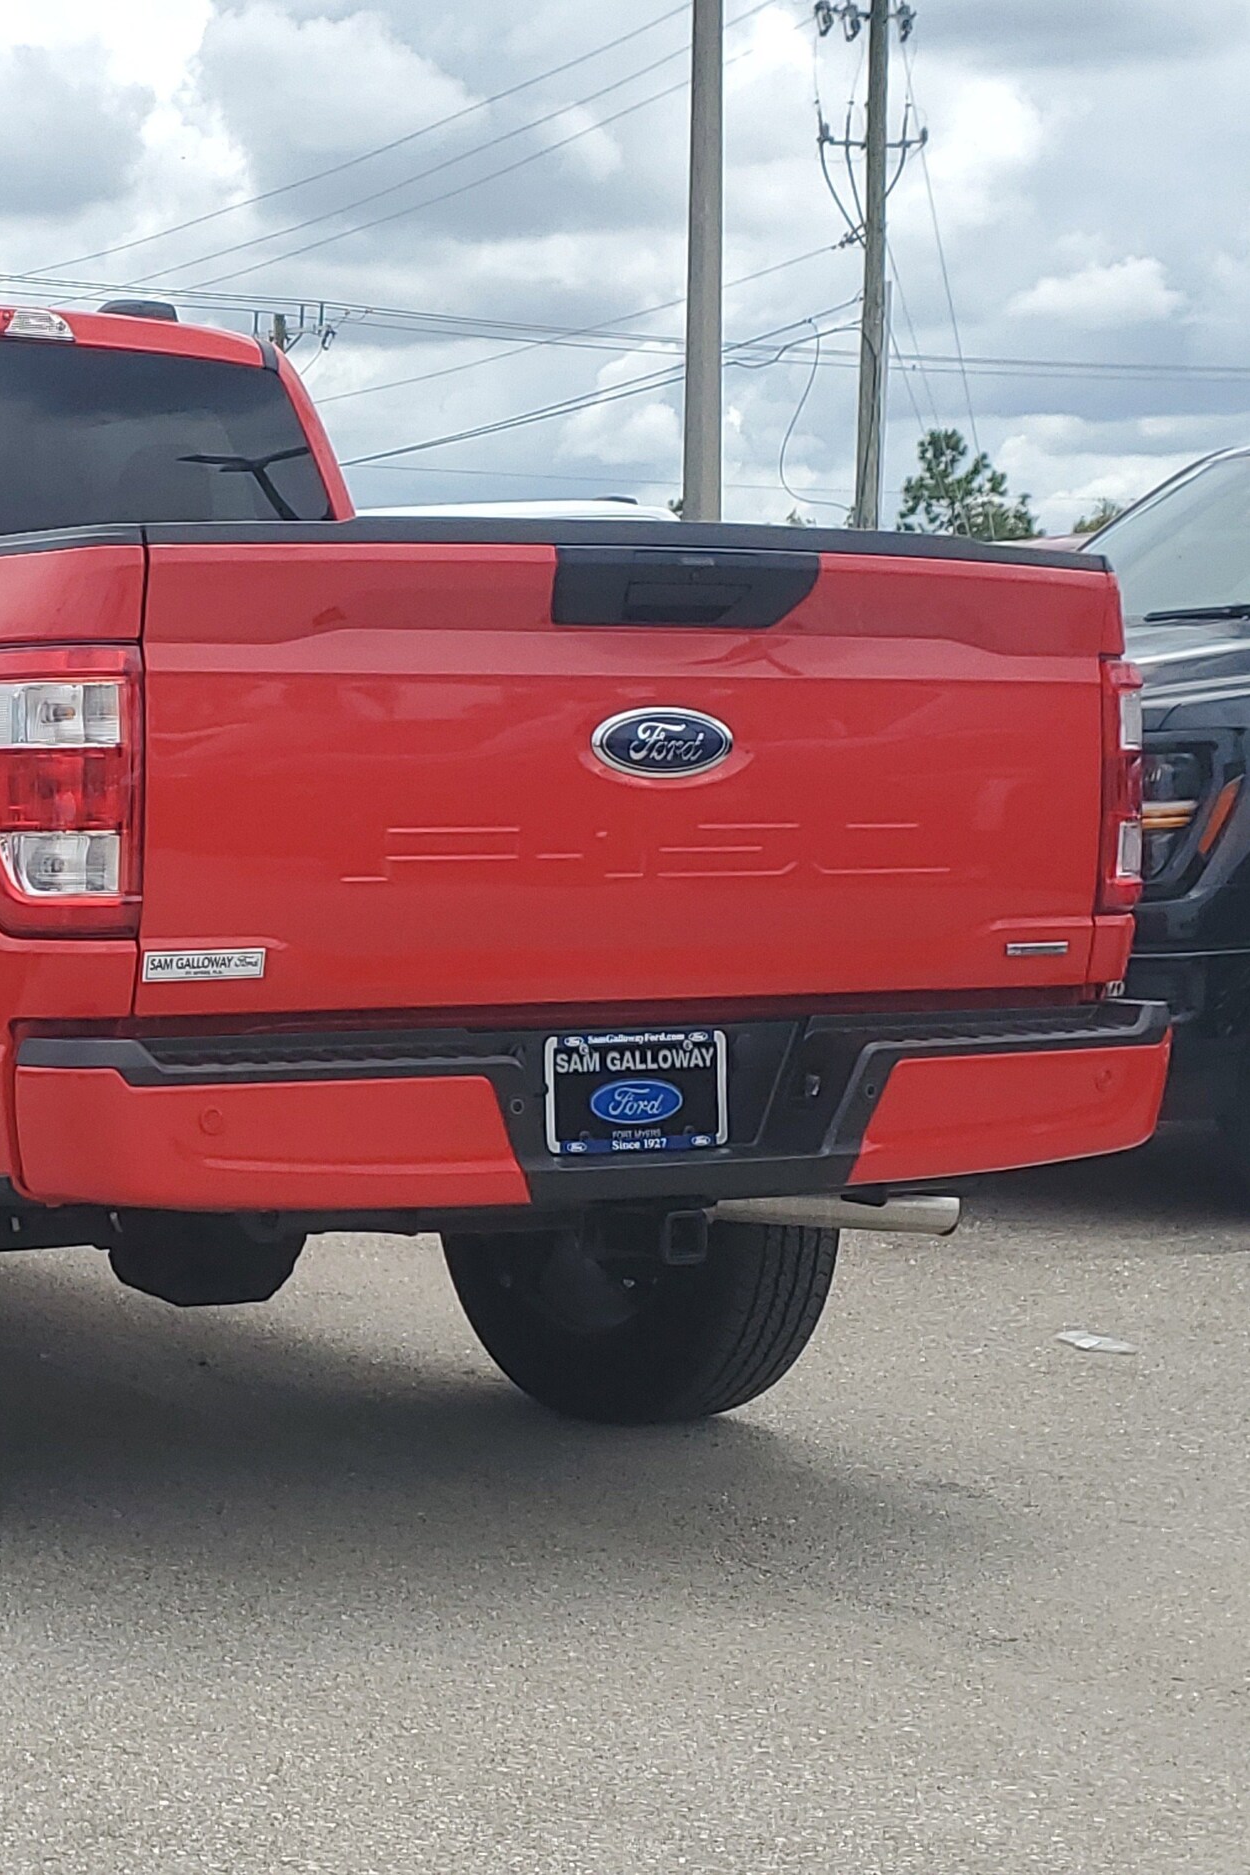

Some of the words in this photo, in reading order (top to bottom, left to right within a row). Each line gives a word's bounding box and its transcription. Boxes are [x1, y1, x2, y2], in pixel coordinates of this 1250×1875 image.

[629, 721, 705, 761] Ford
[150, 958, 173, 971] SAM
[176, 956, 234, 970] GALLOWAY
[235, 955, 259, 968] Ford
[556, 1052, 600, 1073] SAM
[606, 1047, 714, 1072] GALLOWAY
[608, 1087, 664, 1115] Ford
[612, 1129, 632, 1139] FORT
[634, 1128, 661, 1138] MYERS
[612, 1140, 640, 1151] Since
[644, 1138, 667, 1150] 1927
